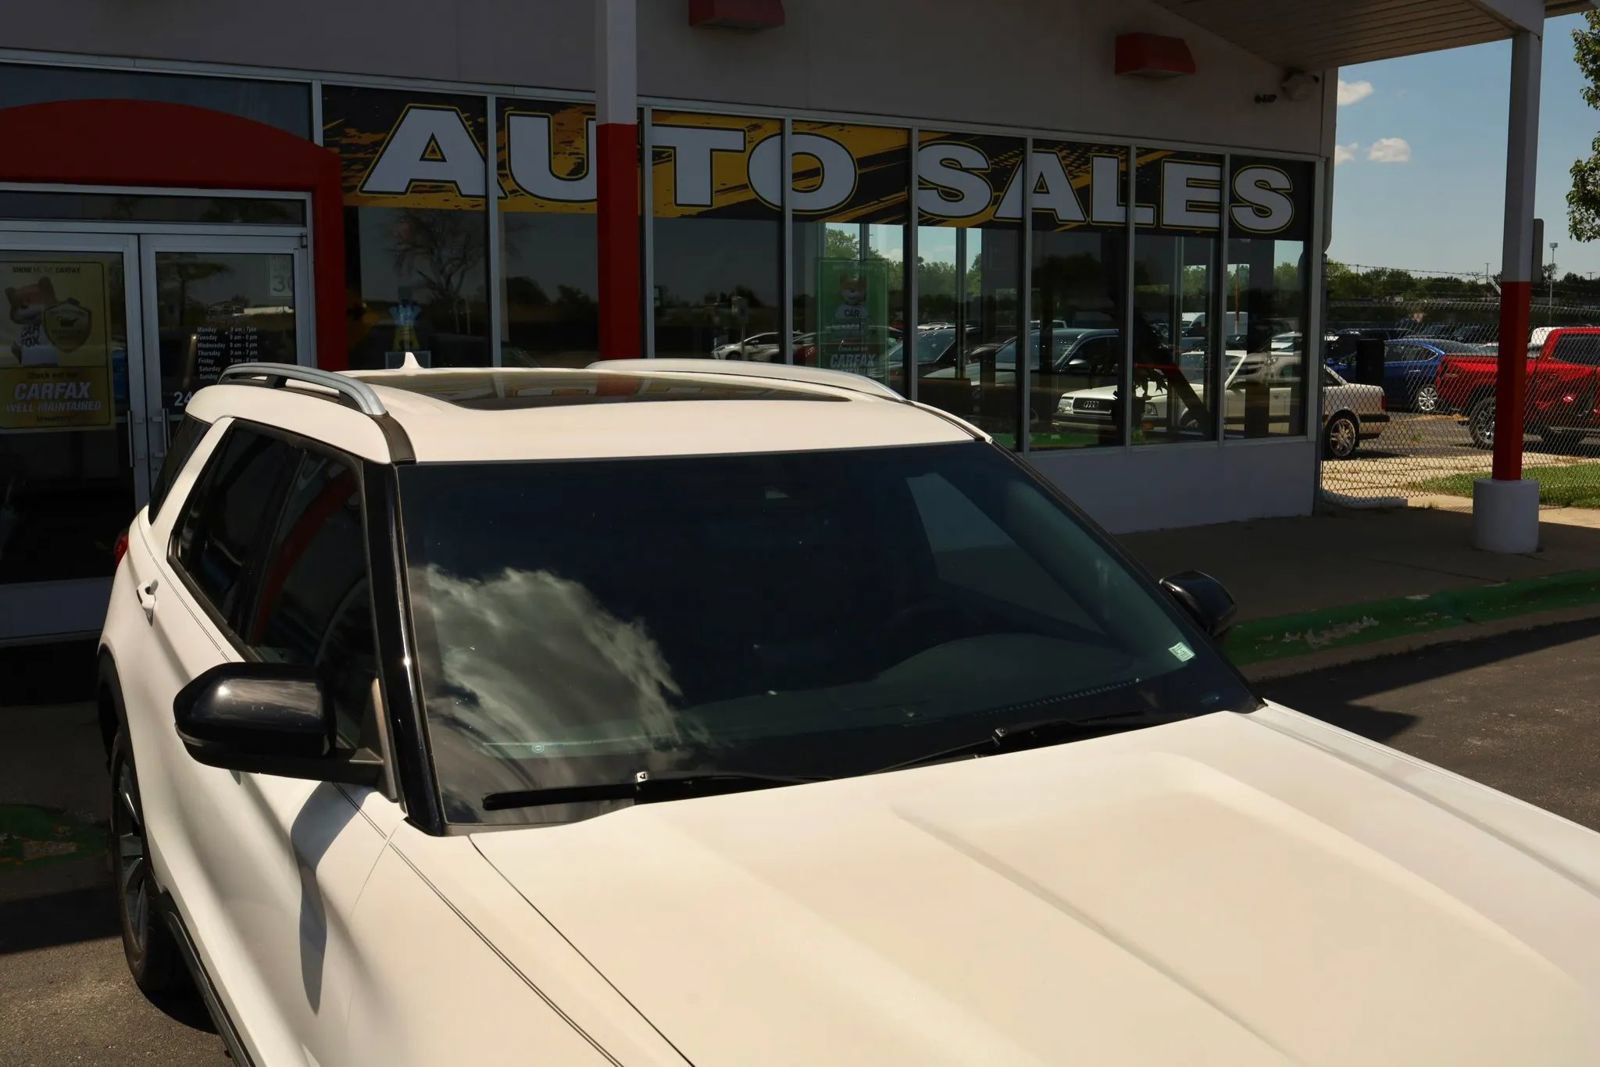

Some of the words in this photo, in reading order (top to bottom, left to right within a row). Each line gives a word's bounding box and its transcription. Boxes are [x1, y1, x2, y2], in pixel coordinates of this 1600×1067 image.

[358, 103, 858, 214] AUTO
[915, 140, 1294, 235] SALES
[199, 365, 221, 373] Saturday
[830, 353, 876, 369] CARFAX
[14, 381, 91, 400] CARFAX
